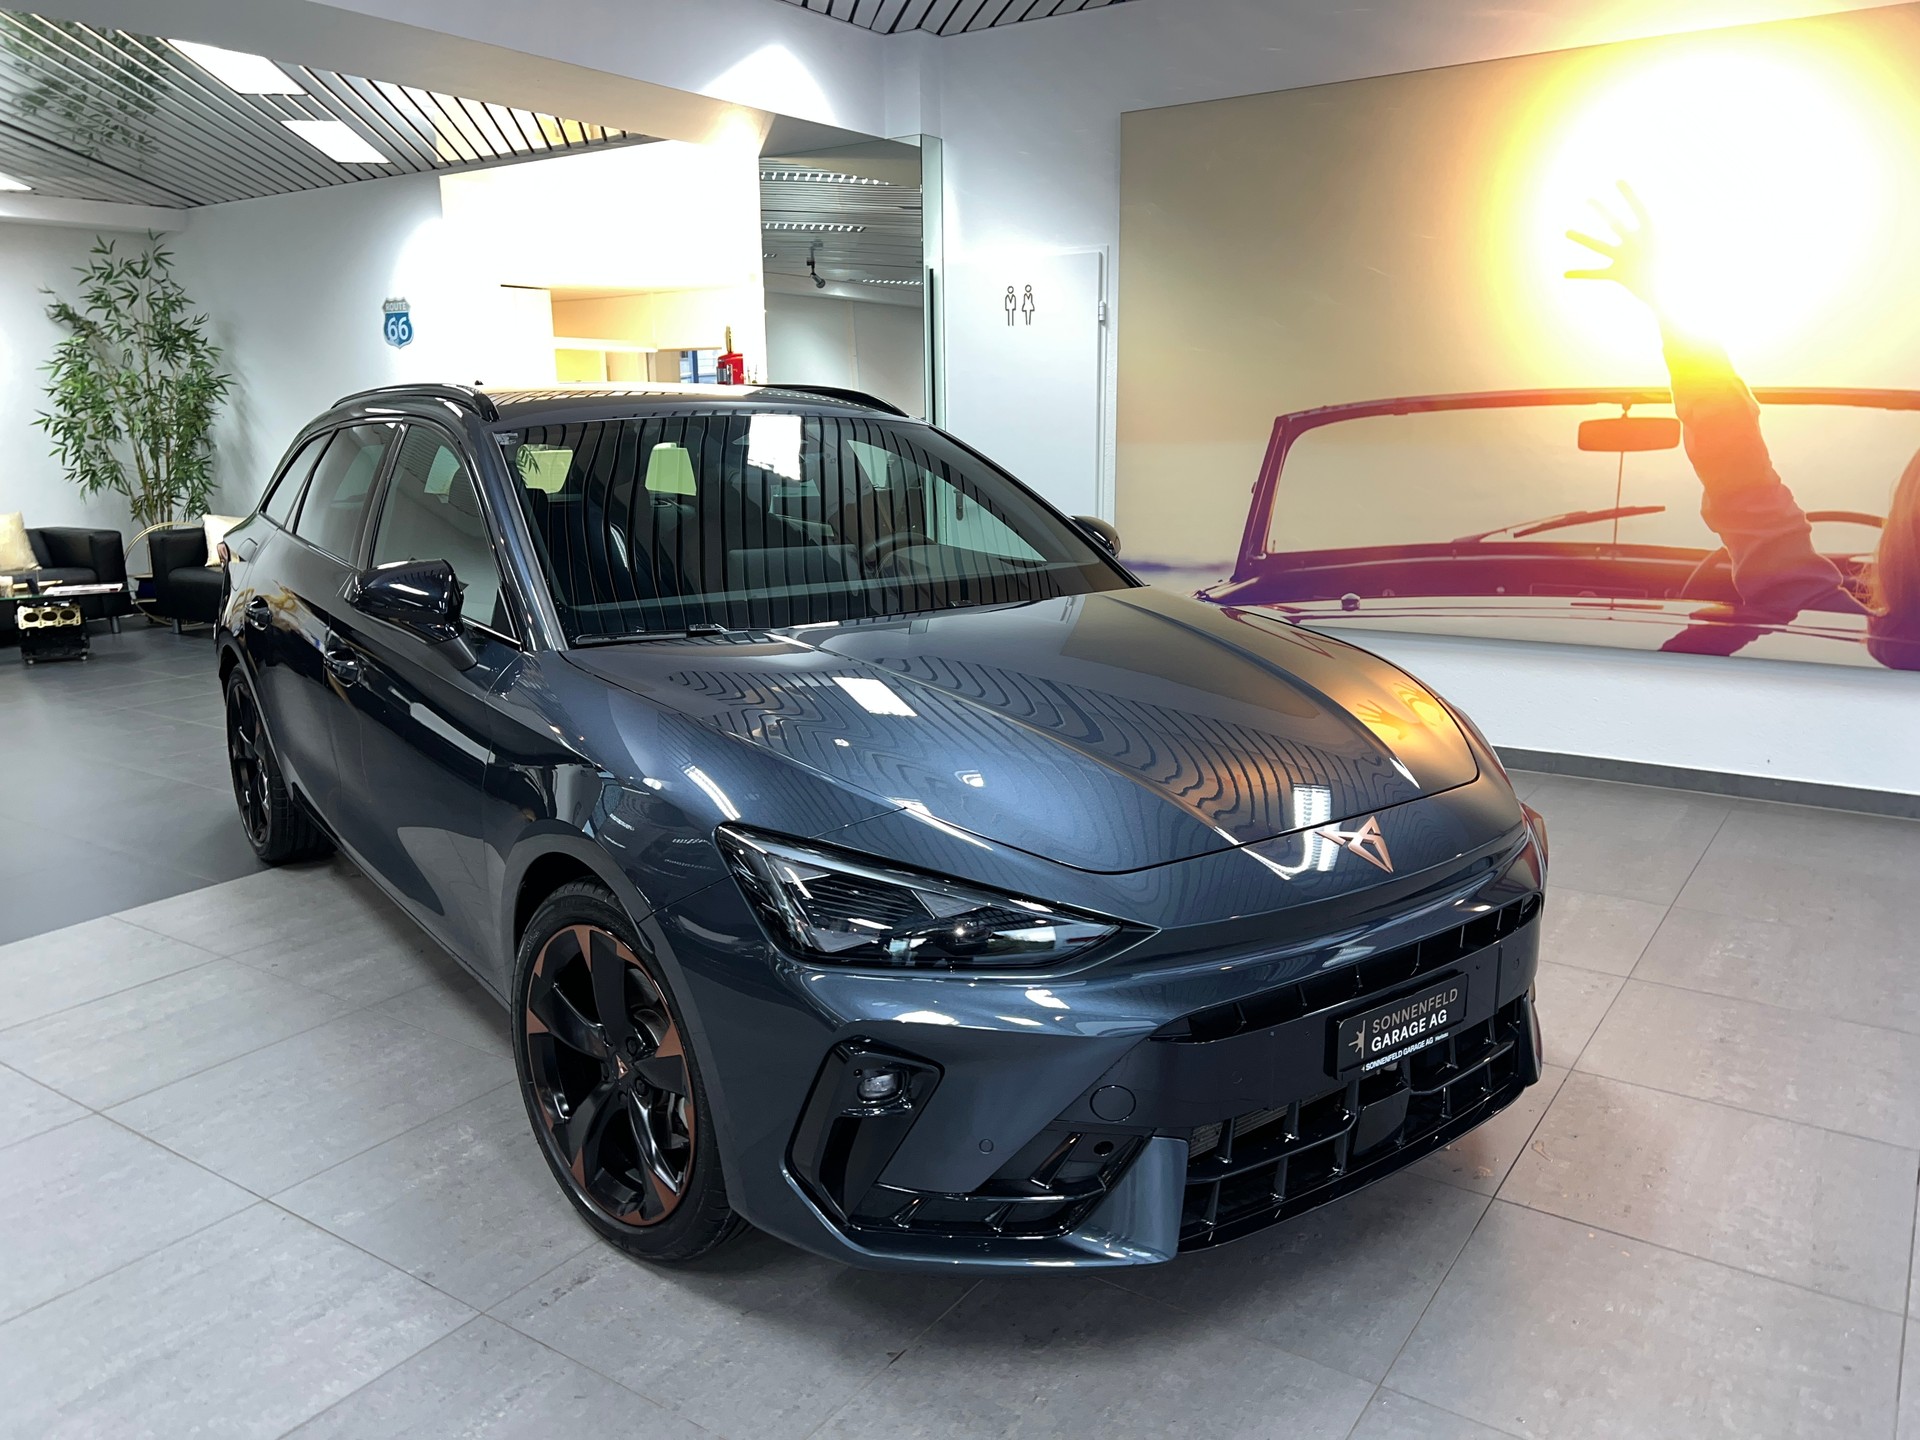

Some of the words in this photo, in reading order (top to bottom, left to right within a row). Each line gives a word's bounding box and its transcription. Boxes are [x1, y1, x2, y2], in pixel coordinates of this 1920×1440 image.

[387, 316, 409, 341] 66
[1372, 988, 1458, 1034] SONNENFELD
[1371, 1018, 1426, 1052] GARAGE
[1429, 1009, 1447, 1029] AG
[1365, 1050, 1403, 1071] SONNENFELD
[1403, 1040, 1425, 1056] GARAGE
